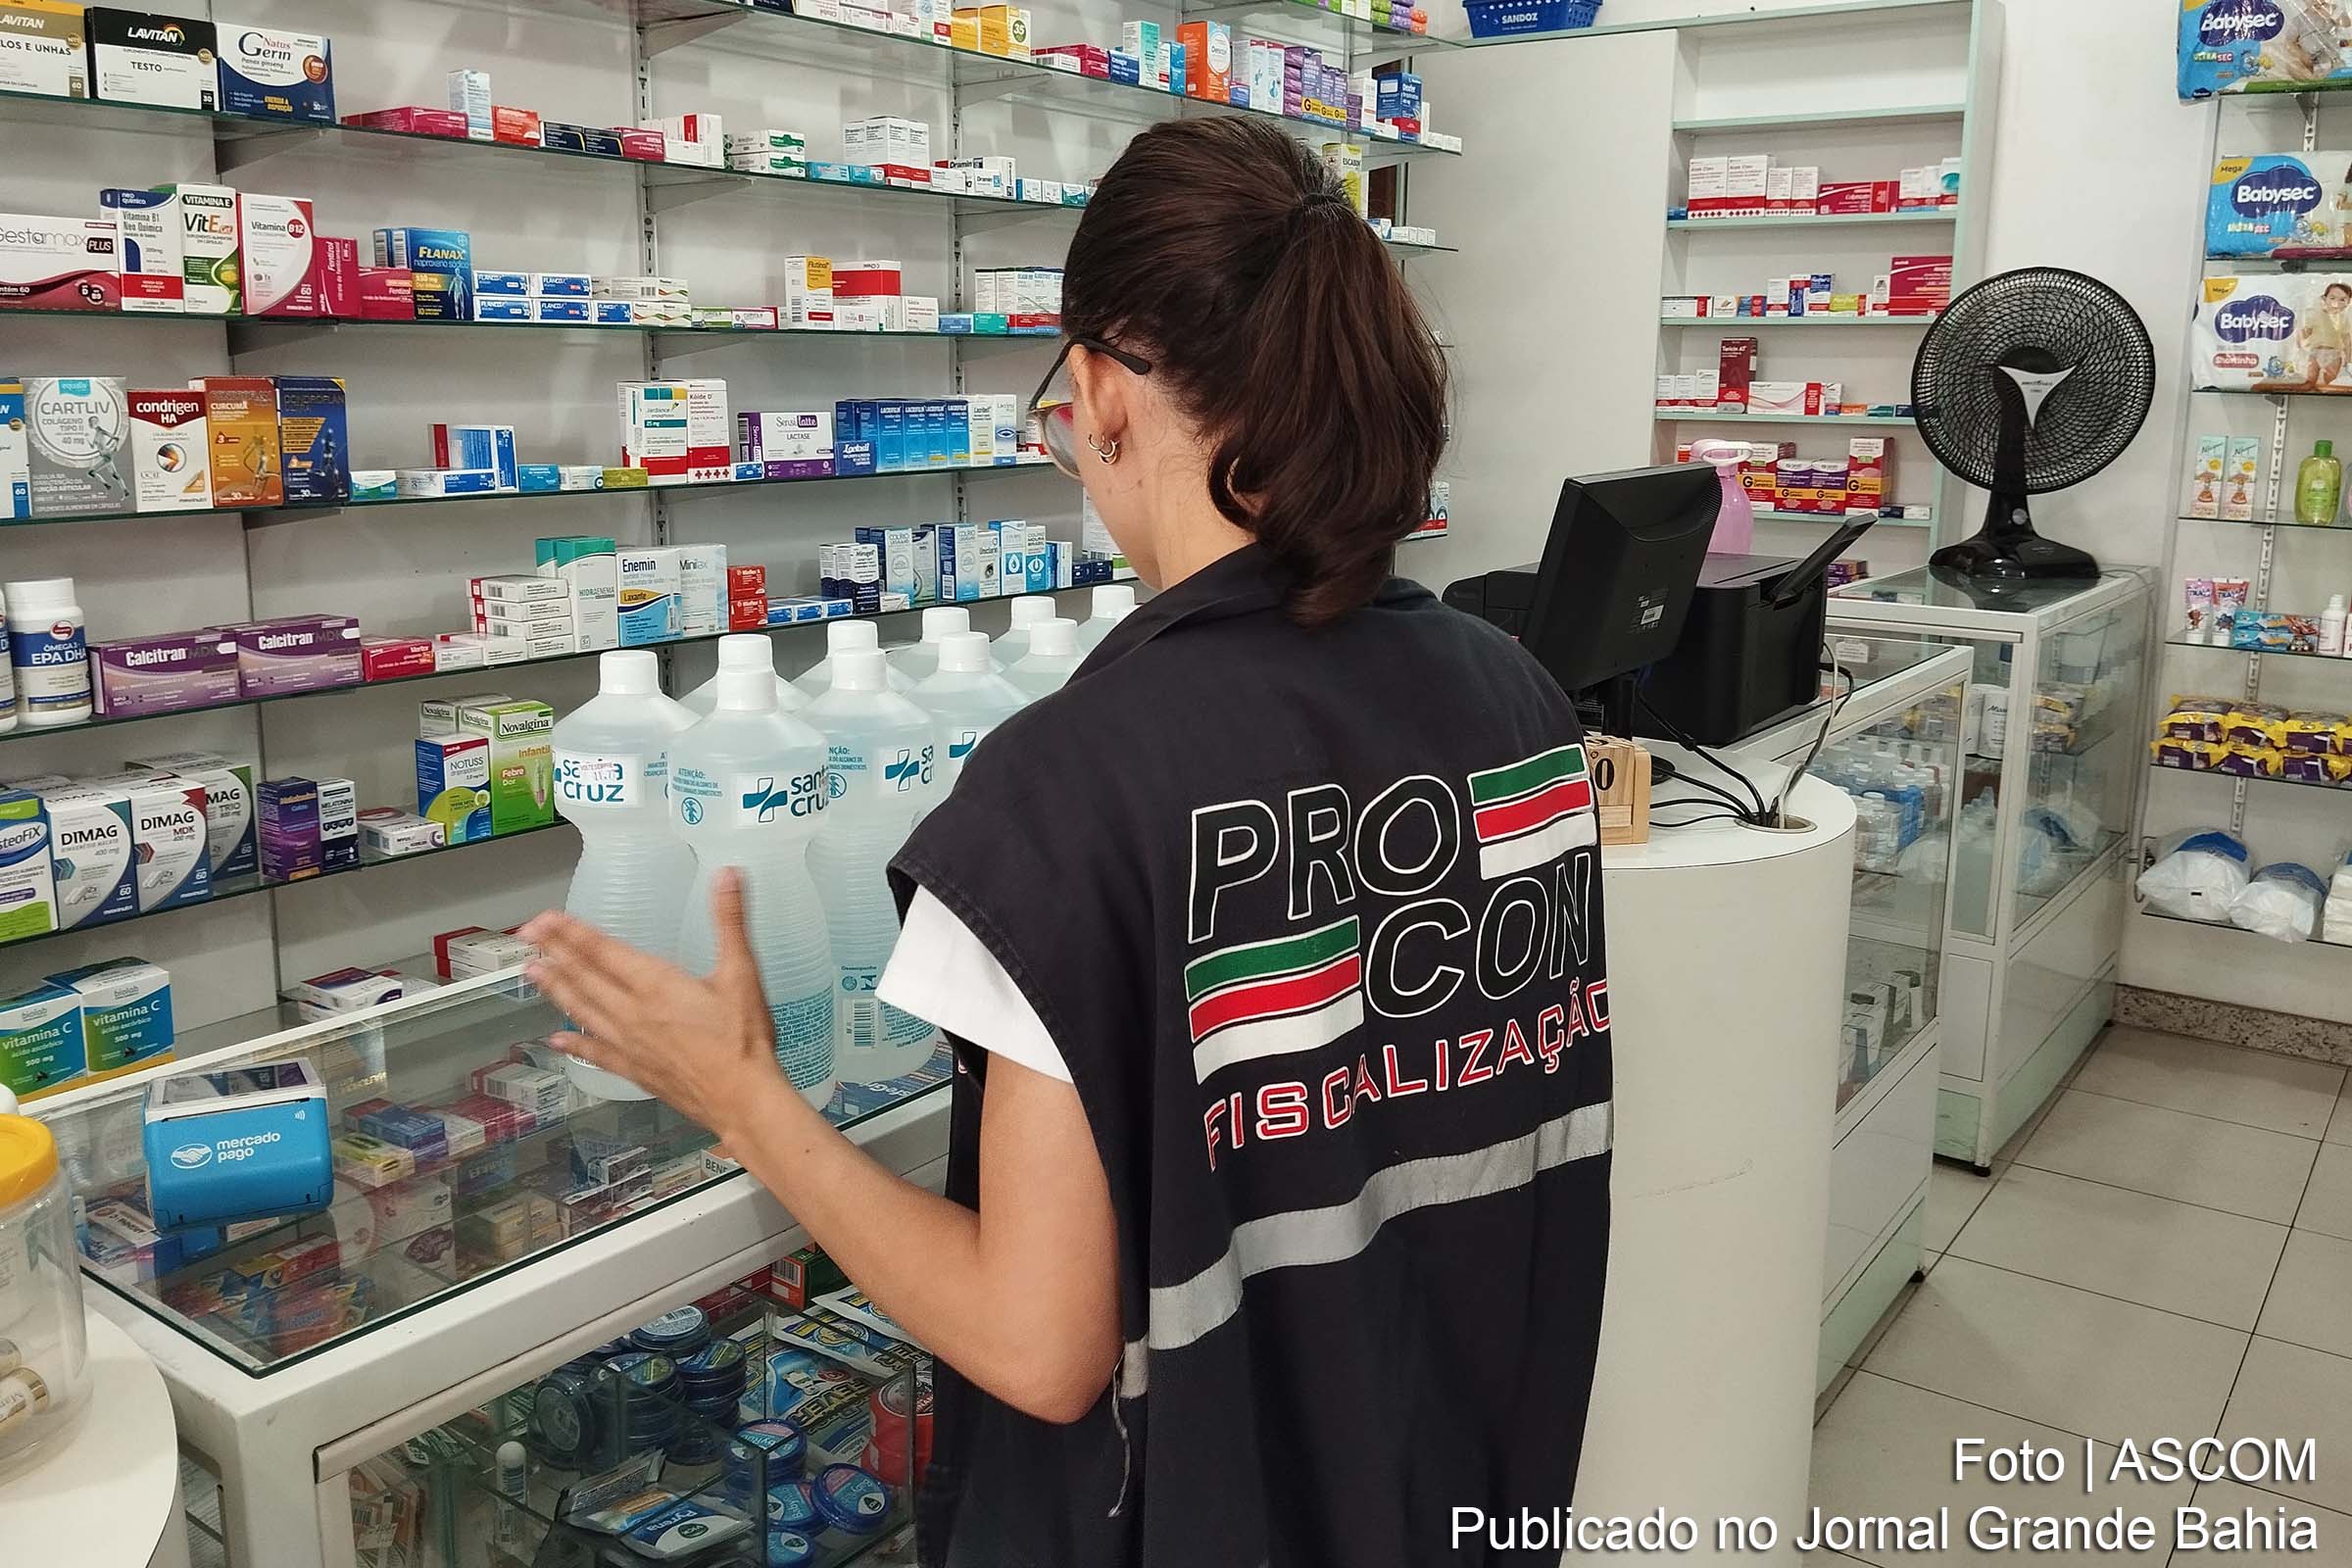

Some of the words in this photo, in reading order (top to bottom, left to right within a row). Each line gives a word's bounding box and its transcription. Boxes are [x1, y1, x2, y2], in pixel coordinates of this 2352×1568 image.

[1501, 13, 1538, 24] SANDOZ
[2201, 12, 2278, 36] Babysec
[127, 26, 178, 43] LAVITAN
[1013, 24, 1025, 35] 35
[0, 39, 21, 51] LOS
[25, 42, 32, 51] E
[35, 43, 72, 56] UNHAS
[238, 32, 292, 61] Gerin
[264, 37, 291, 49] Natus
[130, 61, 163, 73] TESTO
[203, 94, 213, 103] 30
[1303, 98, 1311, 111] G
[950, 160, 973, 170] Dramin
[2221, 163, 2243, 173] Mega
[2236, 184, 2317, 205] Babysec
[185, 195, 224, 207] VITAMINA
[224, 199, 230, 208] E
[122, 211, 150, 222] Vitamina
[251, 220, 286, 232] Vitamina
[287, 223, 305, 234] B12
[87, 239, 113, 252] PLUS
[326, 241, 335, 272] Fentizol
[417, 245, 466, 262] FLANAX
[300, 286, 313, 297] 60
[2220, 312, 2291, 331] Babysec
[40, 402, 111, 415] CARTLIV
[135, 399, 199, 416] condrigen
[42, 416, 83, 425] COLÁGENO
[161, 414, 177, 423] HA
[776, 416, 798, 428] Sensi
[798, 416, 817, 427] latte
[1742, 475, 1753, 488] G
[1848, 479, 1860, 492] G
[231, 492, 242, 502] 30
[301, 488, 312, 498] 30
[1781, 489, 1789, 498] G
[1816, 490, 1825, 499] G
[622, 558, 657, 573] Enemin
[623, 592, 648, 603] Laxante
[43, 643, 73, 652] ÔMEGA
[258, 631, 315, 651] Calcitran
[31, 652, 64, 665] EPA
[65, 647, 87, 662] DHA
[125, 647, 188, 667] Calcitran
[502, 718, 550, 734] Novalgina
[518, 745, 551, 759] Infantil
[450, 756, 484, 770] NOTUSS
[563, 759, 624, 780] saa
[502, 766, 525, 779] Febre
[1594, 758, 1615, 790] 0
[790, 764, 829, 796] sant
[563, 780, 625, 803] cruz
[220, 803, 241, 812] TRIO
[140, 810, 195, 831] DIMAG
[61, 824, 119, 846] DIMAG
[172, 825, 196, 836] MDK
[1188, 774, 1461, 944] PRO
[195, 870, 208, 880] 60
[120, 886, 132, 897] 60
[1365, 852, 1592, 1018] CON
[114, 986, 139, 997] biolab
[22, 1007, 48, 1019] biolab
[93, 1004, 149, 1027] vitamina
[150, 999, 162, 1011] C
[2, 1026, 61, 1052] vitamina
[62, 1021, 74, 1034] C
[115, 1034, 130, 1044] 500
[130, 1030, 143, 1042] mg
[25, 1057, 40, 1067] 500
[42, 1054, 55, 1065] mg
[1203, 976, 1610, 1173] FISCALIZAÇÃO
[217, 1131, 281, 1152] mercado
[218, 1146, 255, 1164] pago
[647, 1509, 698, 1533] Pyrena
